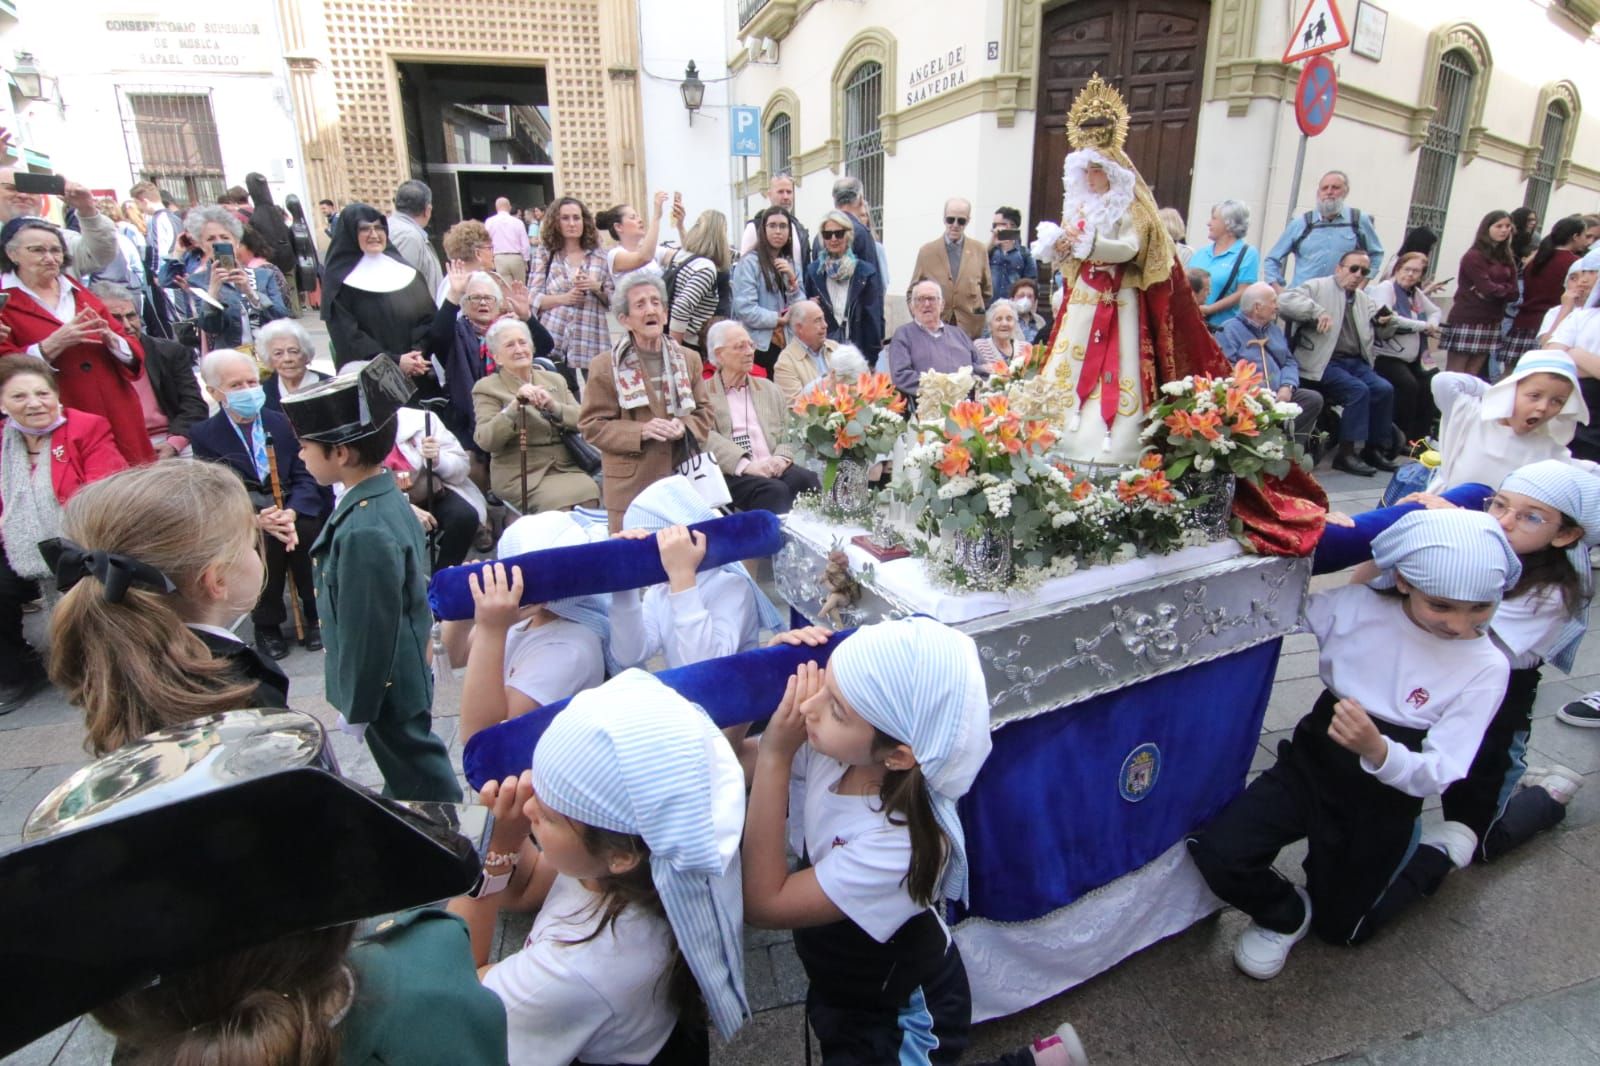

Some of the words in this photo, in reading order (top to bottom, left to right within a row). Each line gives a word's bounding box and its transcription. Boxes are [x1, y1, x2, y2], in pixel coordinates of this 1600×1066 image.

[948, 46, 963, 67] DE
[906, 69, 965, 106] SAAVEDRA
[738, 111, 753, 133] P
